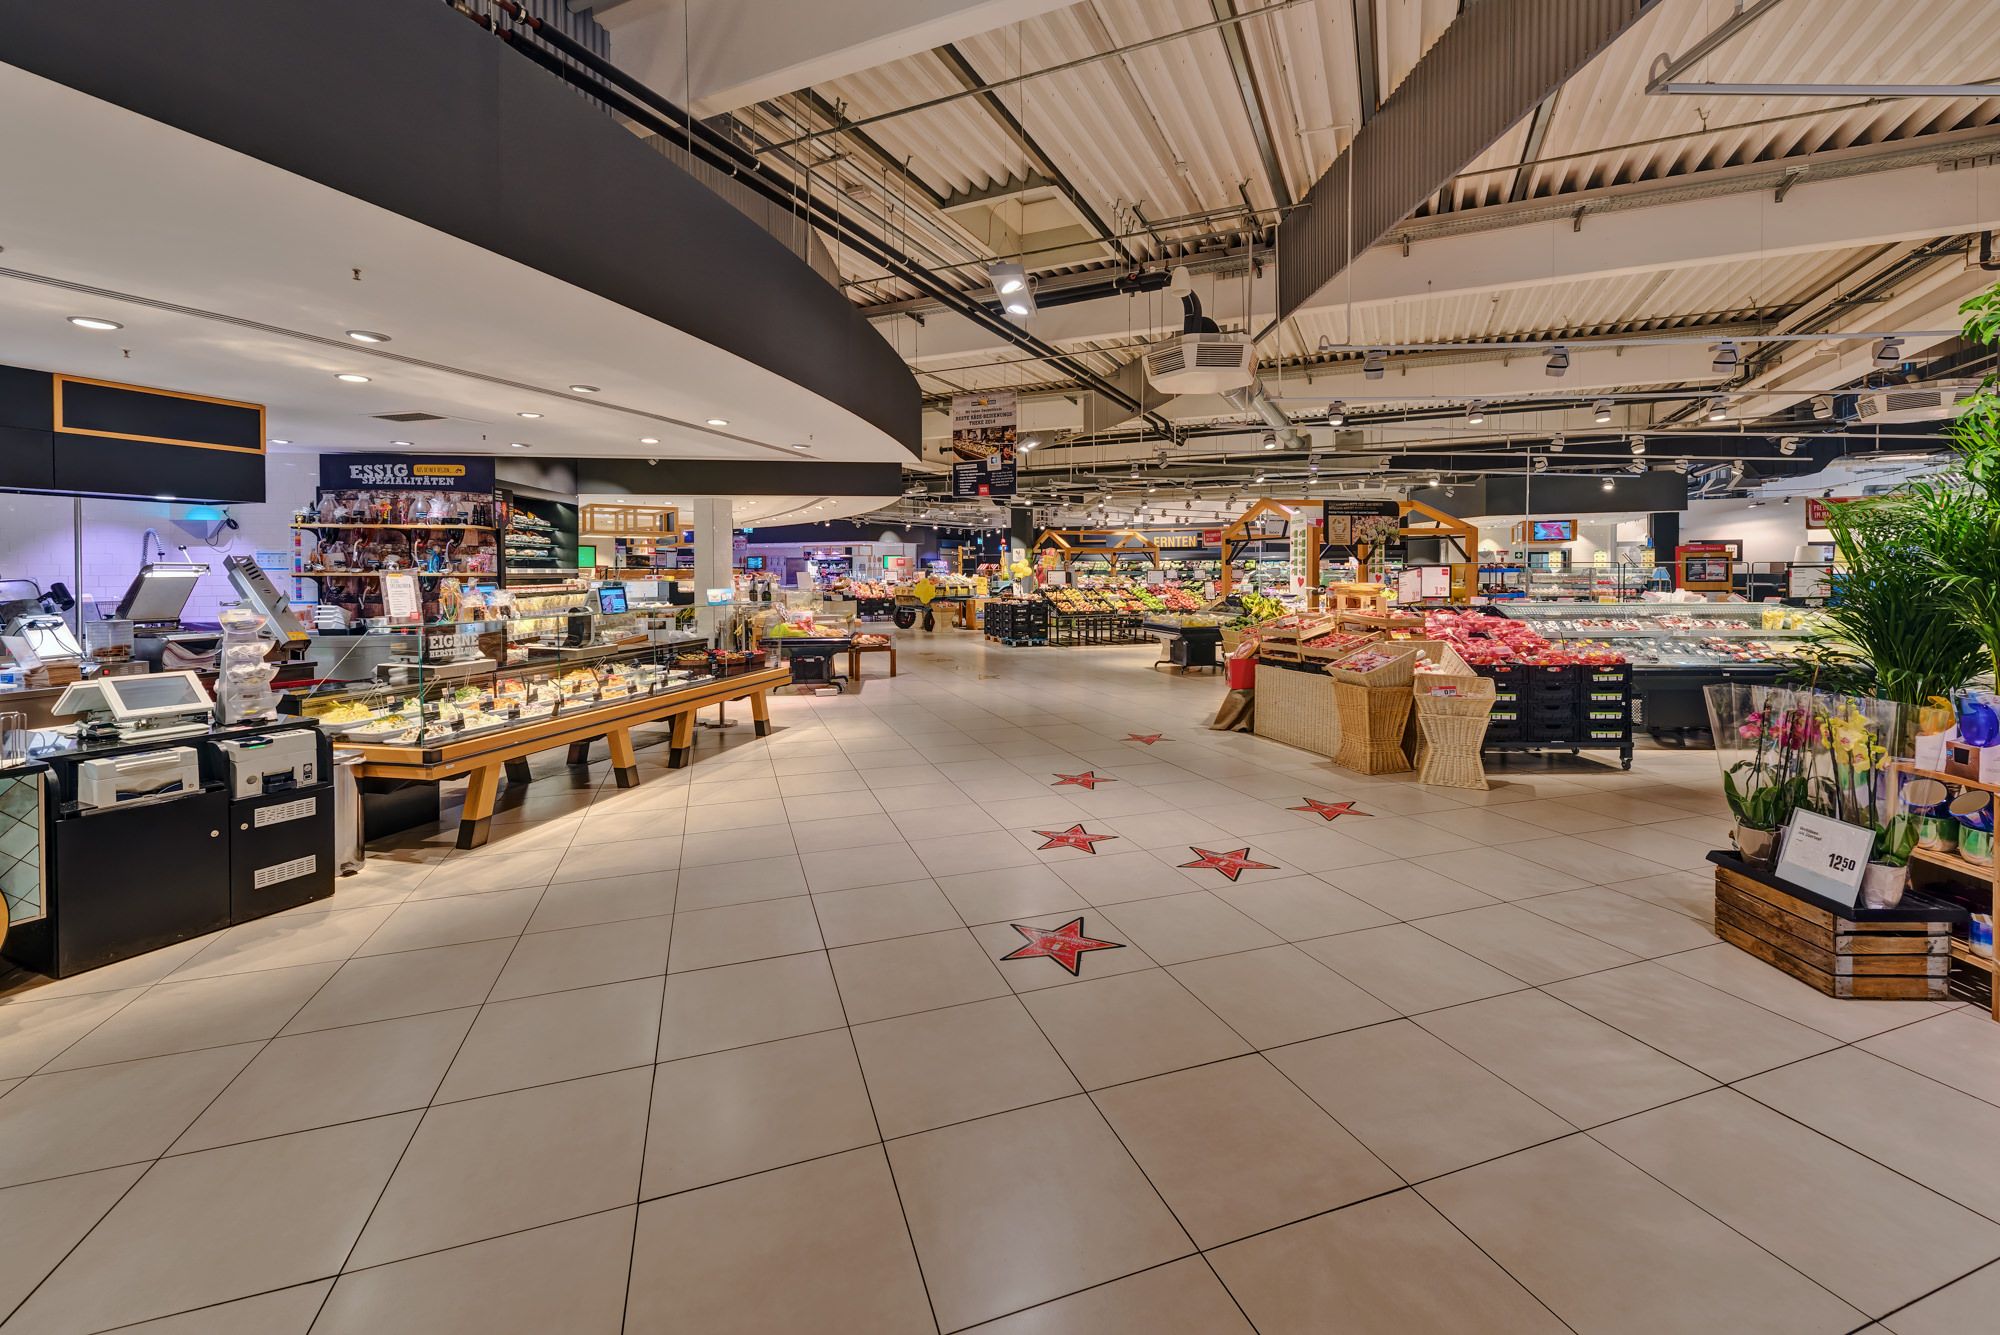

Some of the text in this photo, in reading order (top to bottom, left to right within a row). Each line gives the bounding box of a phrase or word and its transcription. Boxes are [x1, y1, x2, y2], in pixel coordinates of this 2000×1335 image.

[349, 464, 408, 478] ESSIG
[362, 476, 454, 485] SPEZIALITÄTEN
[1154, 536, 1196, 547] ERNTEN
[429, 634, 479, 648] EIGENE
[429, 646, 479, 658] HERSTELLUNG
